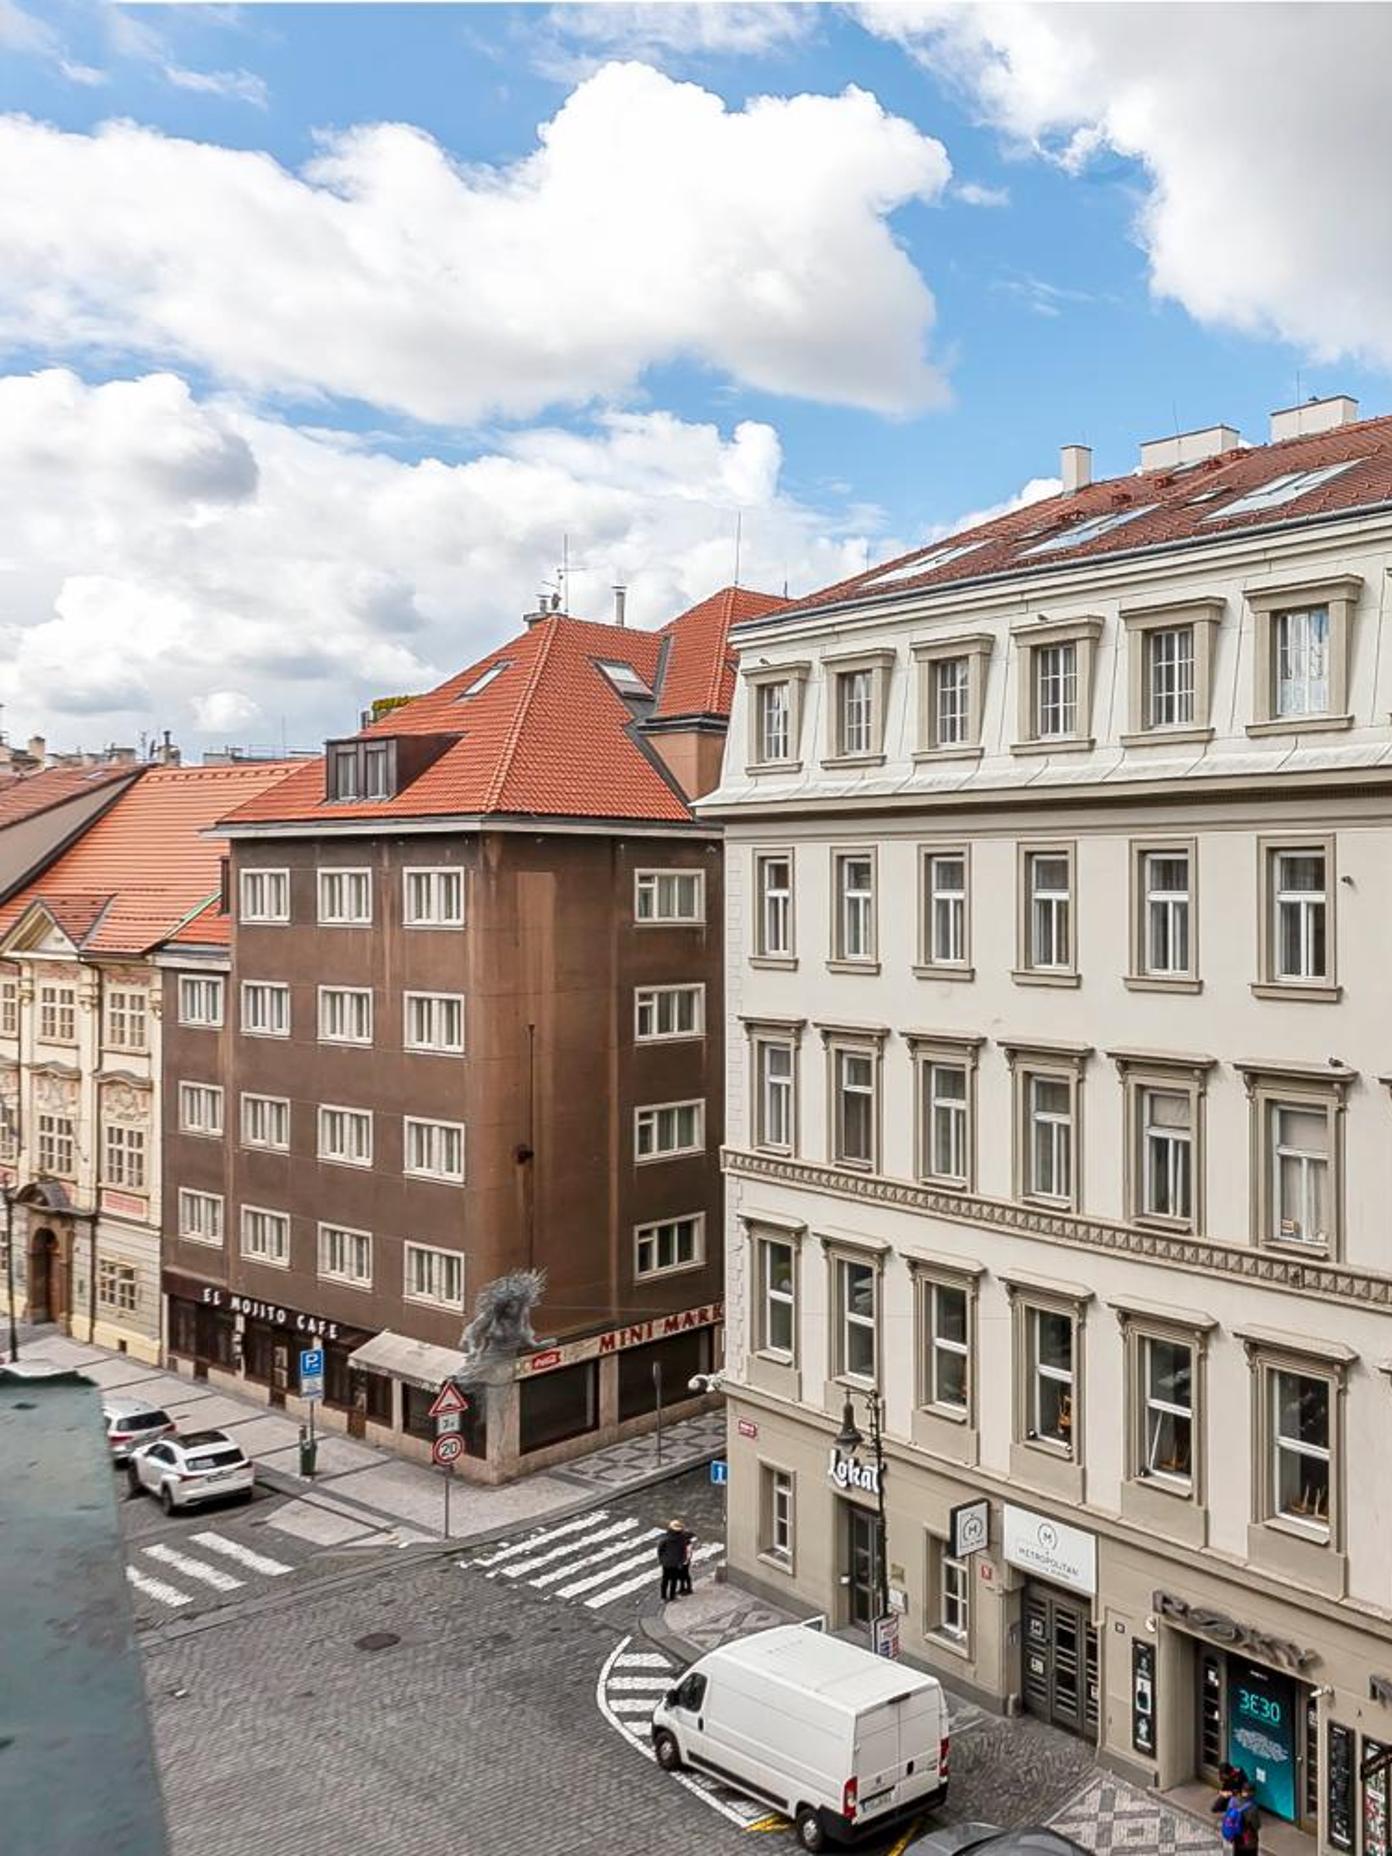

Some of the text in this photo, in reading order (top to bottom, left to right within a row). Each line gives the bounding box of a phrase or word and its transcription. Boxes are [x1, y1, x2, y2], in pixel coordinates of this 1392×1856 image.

[203, 1287, 337, 1340] EL MOJITO CAFE
[600, 1321, 654, 1354] MINI
[305, 1353, 319, 1370] P
[441, 1440, 458, 1457] 20
